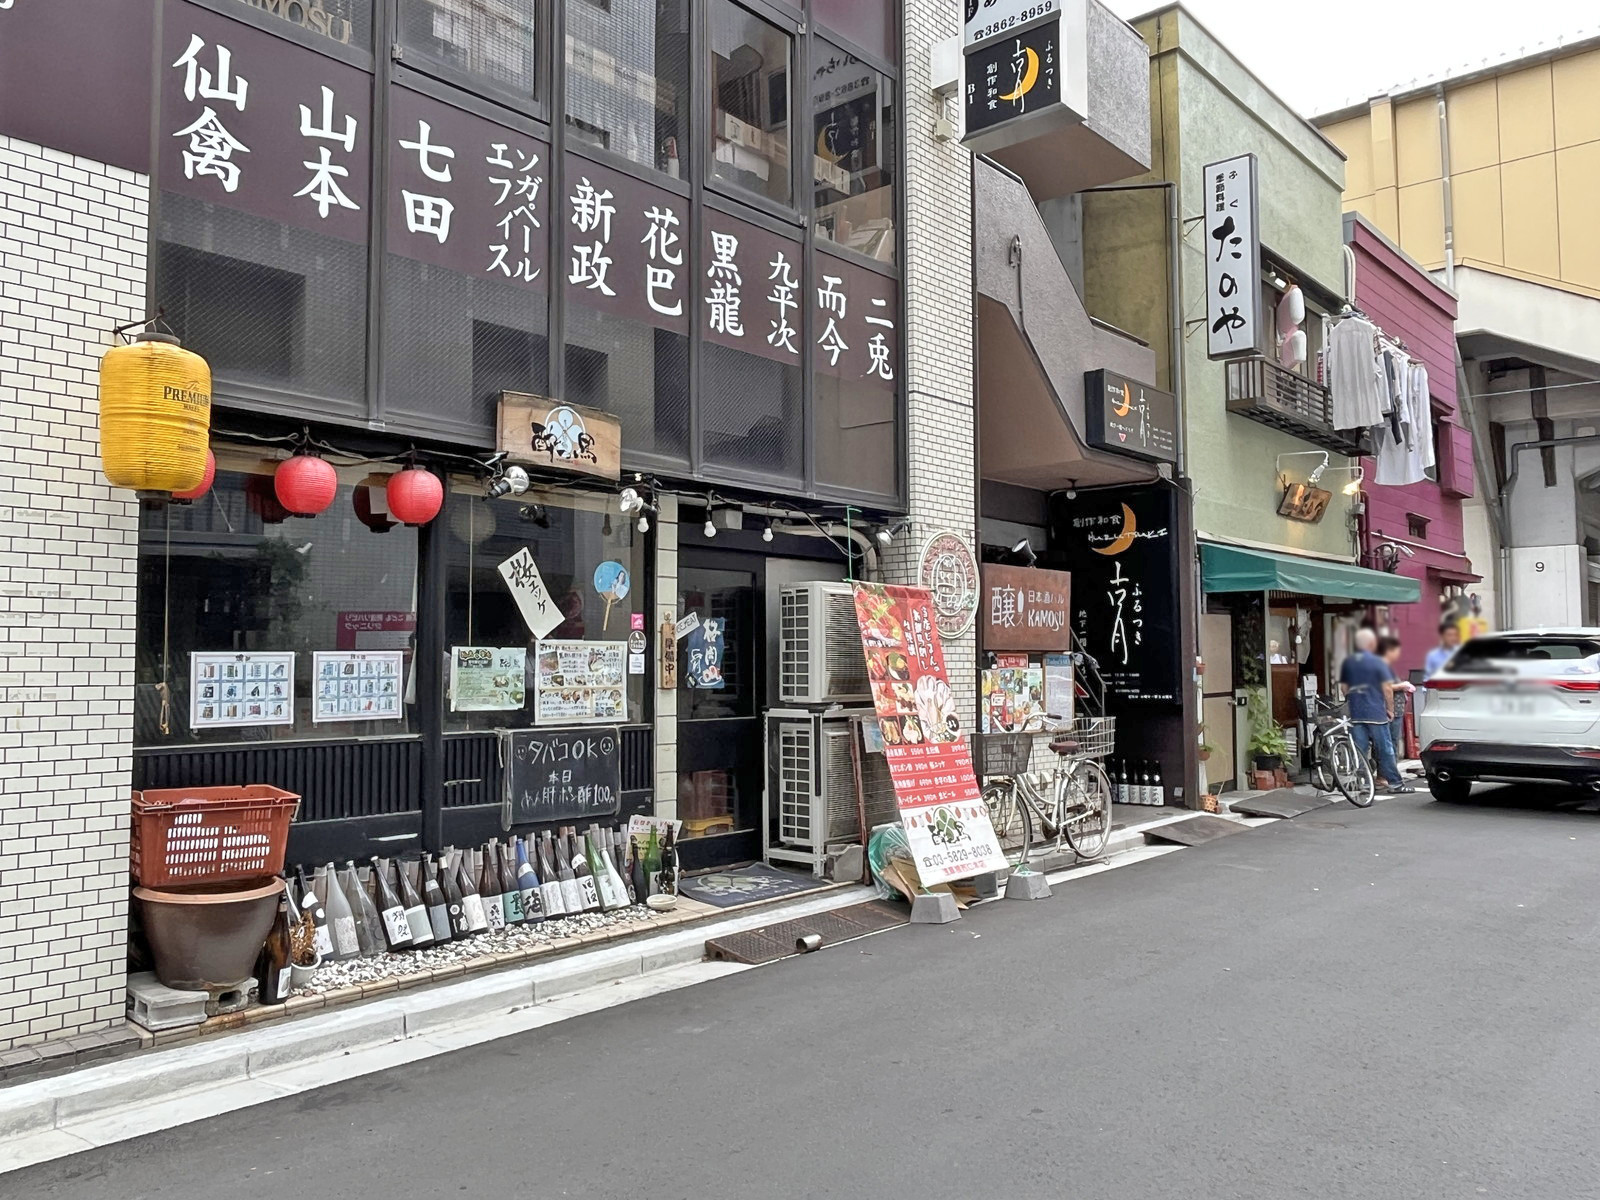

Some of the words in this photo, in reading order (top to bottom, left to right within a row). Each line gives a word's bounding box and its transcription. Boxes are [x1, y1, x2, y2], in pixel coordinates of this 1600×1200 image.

[985, 0, 1052, 36] 3862-8959
[172, 33, 250, 193] 仙禽
[986, 62, 998, 110] 創作和食
[293, 85, 361, 219] 山本
[398, 120, 456, 244] 七田
[1228, 170, 1238, 208] ふぐ
[568, 176, 617, 296] 新政
[640, 205, 684, 317] 花巴
[704, 231, 745, 338] 黒龍
[1211, 215, 1246, 345] たのや
[767, 251, 800, 355] 九平次
[817, 274, 850, 367] 而今
[1132, 582, 1143, 646] ふるつき
[1535, 561, 1545, 573] 9
[1028, 608, 1065, 632] KAMOSU
[548, 769, 572, 784] 本日
